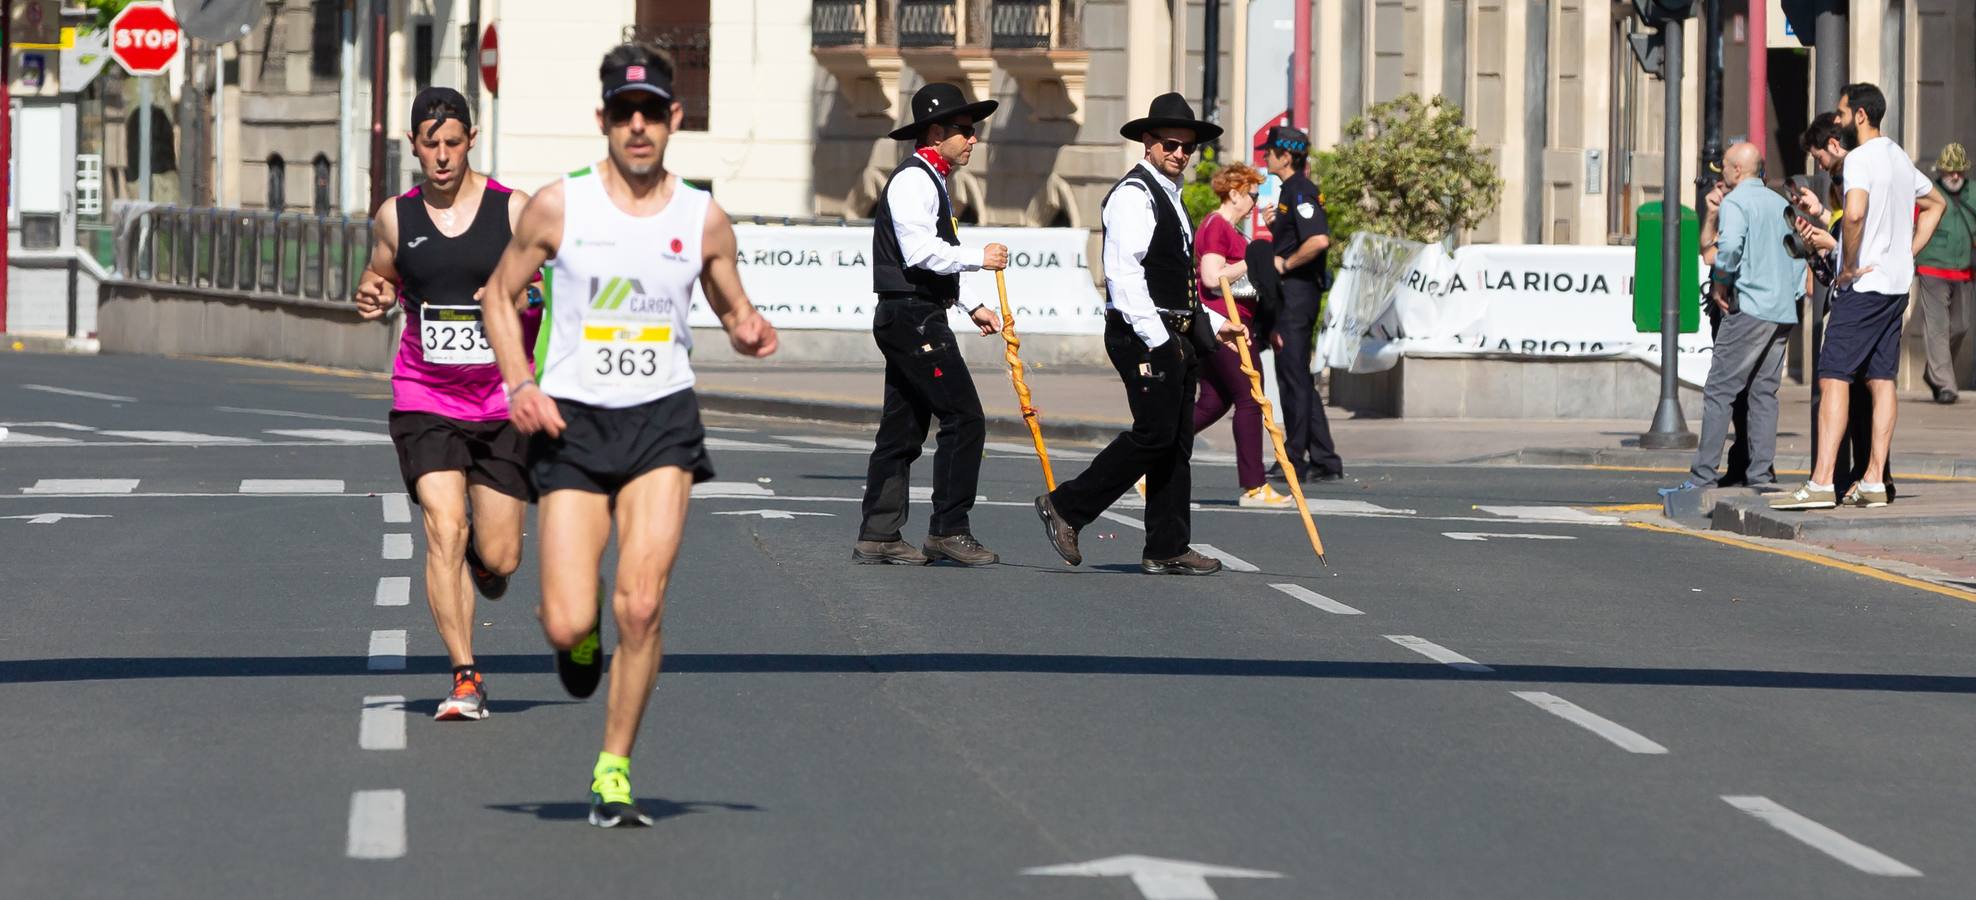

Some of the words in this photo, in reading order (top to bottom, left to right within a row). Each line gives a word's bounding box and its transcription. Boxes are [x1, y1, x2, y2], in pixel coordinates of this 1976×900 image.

[115, 28, 178, 48] STOP
[754, 250, 822, 266] RIOJA
[838, 250, 866, 266] LA
[1007, 252, 1061, 268] IOJA
[1484, 270, 1517, 290] LA
[1524, 271, 1610, 294] RIOJA
[630, 297, 673, 313] CARGO
[596, 348, 656, 376] 363
